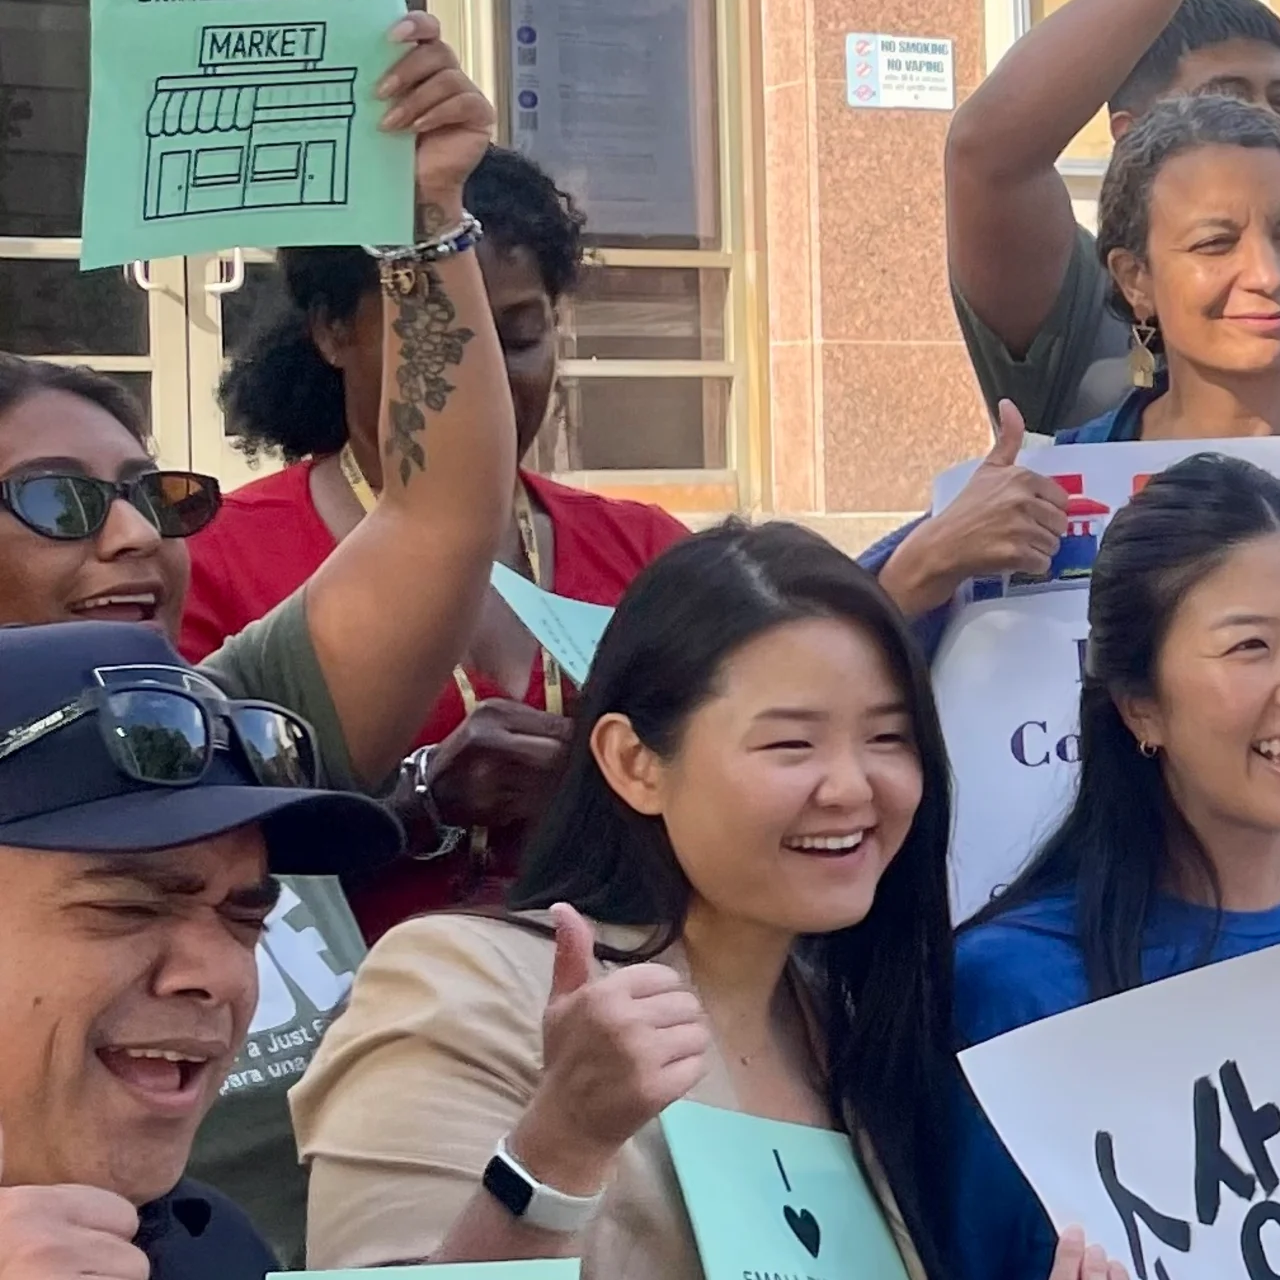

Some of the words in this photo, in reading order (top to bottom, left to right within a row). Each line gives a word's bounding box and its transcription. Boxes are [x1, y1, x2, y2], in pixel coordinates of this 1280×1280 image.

[208, 26, 317, 61] MARKET
[880, 40, 896, 53] NO
[898, 40, 949, 56] SMOKING
[887, 58, 902, 72] NO
[904, 59, 944, 73] VAPING
[266, 1025, 314, 1053] Just
[772, 1148, 791, 1193] I
